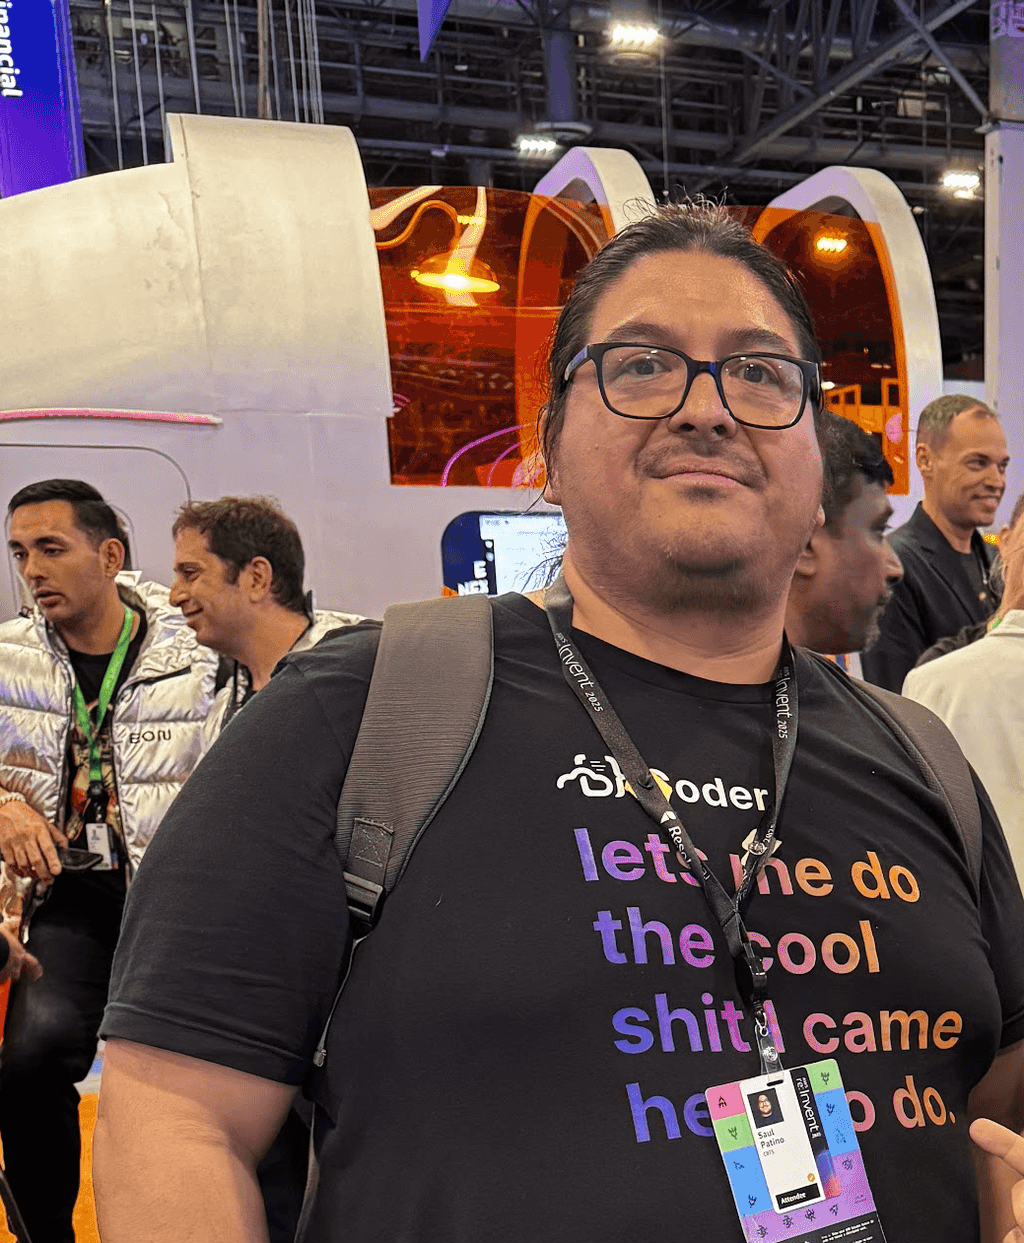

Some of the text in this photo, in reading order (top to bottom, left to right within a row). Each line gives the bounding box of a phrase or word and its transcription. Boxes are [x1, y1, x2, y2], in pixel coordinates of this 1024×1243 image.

[0, 0, 23, 97] inancial
[584, 691, 604, 712] 2025
[777, 719, 788, 739] 2025
[850, 851, 921, 903] do
[592, 906, 881, 975] the cool
[611, 992, 751, 1054] shit
[802, 1009, 964, 1054] came
[796, 1077, 820, 1133] re:Invent
[892, 1074, 957, 1130] do.
[757, 1127, 776, 1140] Saul
[760, 1137, 786, 1149] Patino
[781, 1192, 807, 1205] Attendee
